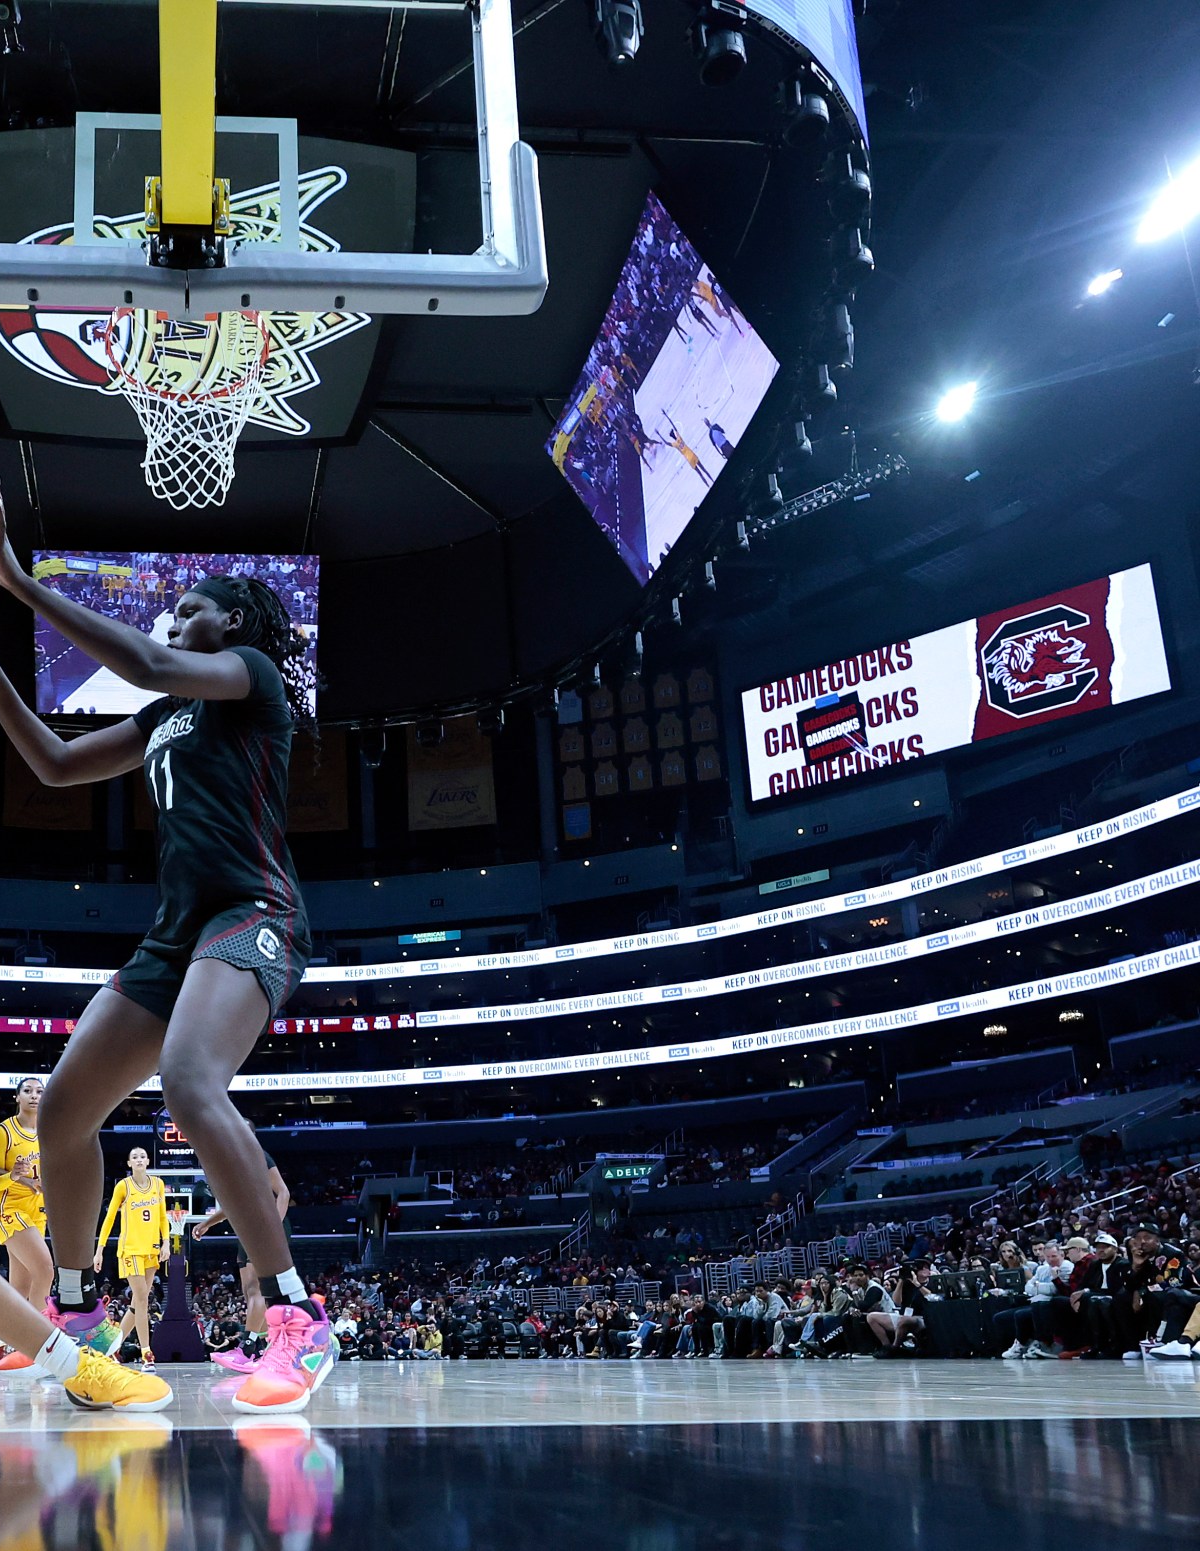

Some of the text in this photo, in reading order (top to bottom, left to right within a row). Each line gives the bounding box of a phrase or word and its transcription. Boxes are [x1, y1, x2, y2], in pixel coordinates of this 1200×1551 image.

[760, 640, 912, 712] GAMECOCKS
[806, 718, 860, 747] GAMECOCKS
[149, 750, 173, 810] 11
[1076, 808, 1157, 844] KEEP ON RISING
[1005, 852, 1025, 862] UCLA
[911, 863, 983, 891] KEEP ON RISING
[846, 895, 865, 905] UCLA
[997, 881, 1145, 932] KEEP ON OVERCOMING EVERY
[757, 903, 826, 925] KEEP ON RISING
[413, 931, 445, 939] AMERICAN
[699, 927, 715, 936] UCLA
[614, 932, 680, 949] KEEP ON RISING
[929, 937, 947, 947] UCLA
[477, 953, 540, 967] KEEP ON RISING
[724, 945, 908, 989] KEEP ON OVERCOMING EVERY CHALLENGE
[345, 965, 405, 978] KEEP ON RISING
[1008, 957, 1160, 1001] KEEP ON OVERCOMING EVERY
[664, 988, 681, 997] UCLA
[477, 992, 644, 1019] KEEP ON OVERCOMING EVERY CHALLENGE
[940, 1004, 958, 1014] UCLA
[732, 1011, 918, 1050] KEEP ON OVERCOMING EVERY CHALLENGE
[670, 1049, 688, 1057] UCLA
[483, 1050, 650, 1076] KEEP ON OVERCOMING EVERY CHALLENGE
[246, 1072, 406, 1086] KEEP ON OVERCOMING EVERY CHALLENGE
[130, 1198, 150, 1210] Southern
[142, 1210, 151, 1222] 9
